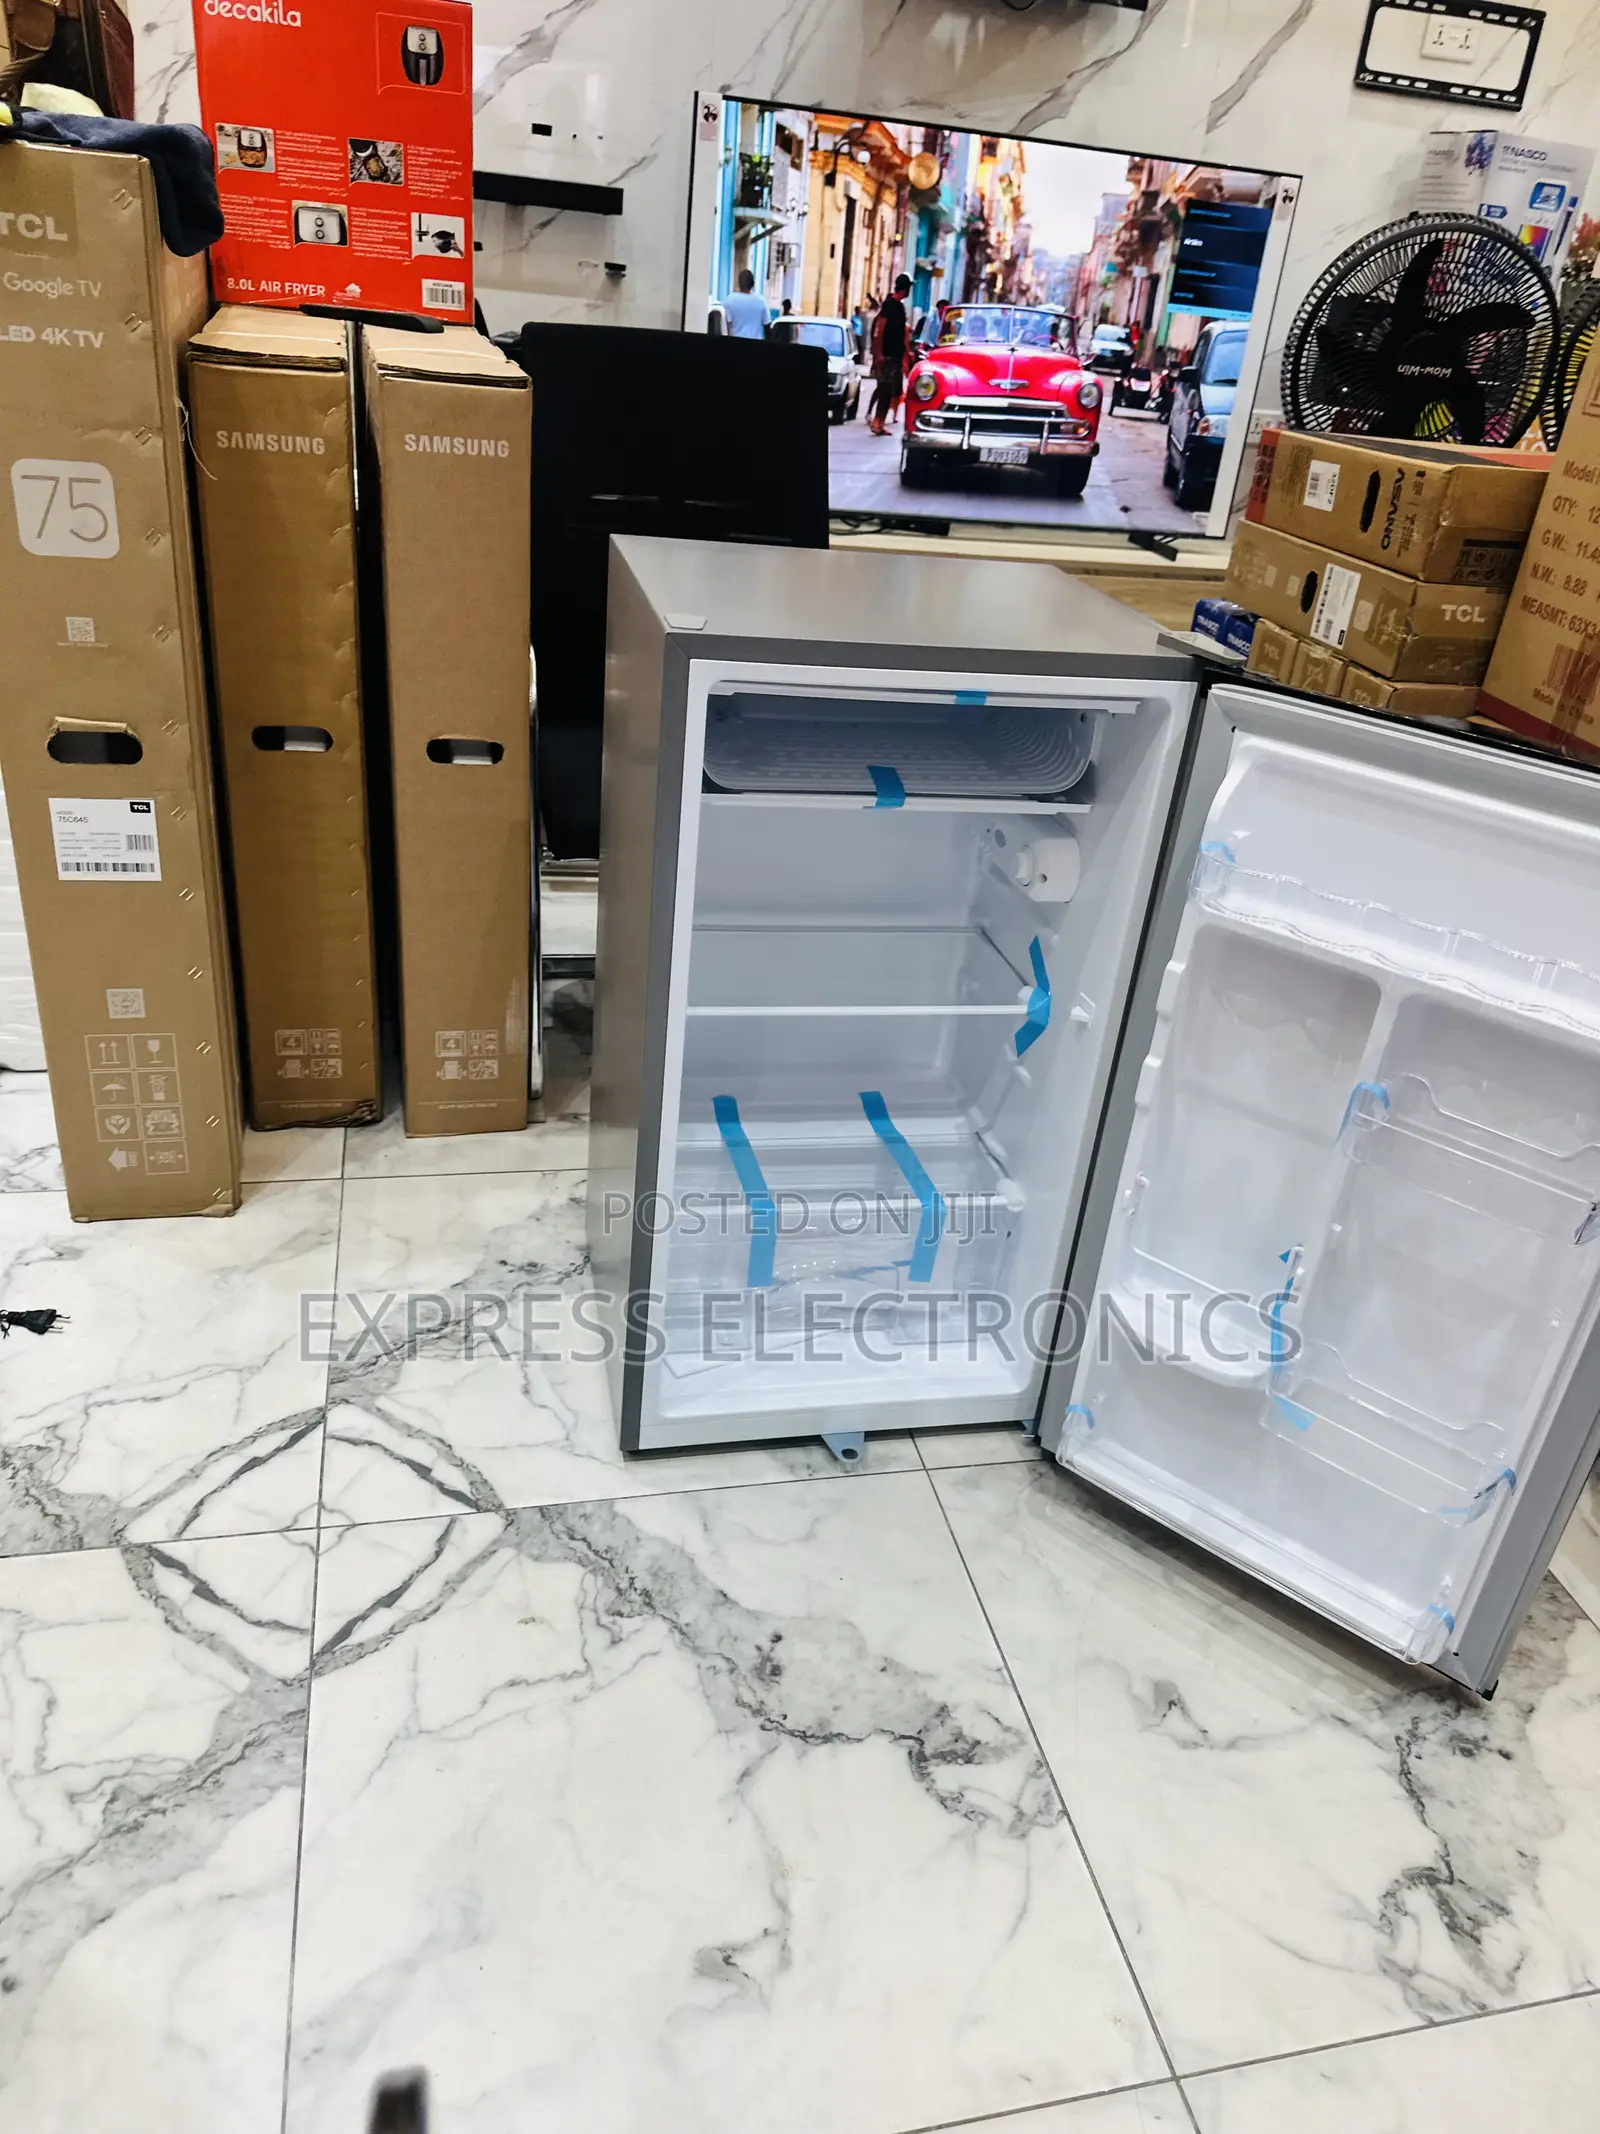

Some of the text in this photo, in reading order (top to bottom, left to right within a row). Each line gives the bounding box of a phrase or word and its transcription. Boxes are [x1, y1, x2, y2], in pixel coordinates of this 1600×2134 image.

[203, 0, 302, 27] decakila
[0, 211, 68, 241] TCL
[4, 271, 102, 299] Google TV
[227, 277, 255, 291] 8.0L
[259, 280, 281, 293] AIR
[284, 282, 326, 298] FRYER
[0, 325, 105, 349] ED 4K TV
[216, 430, 325, 455] SAMSUNG
[404, 433, 509, 458] SAMSUNG
[1562, 459, 1596, 484] Model
[20, 474, 108, 542] 75
[1381, 467, 1406, 551] ASANO
[1552, 495, 1578, 518] QTY:
[1440, 604, 1486, 623] TCL
[132, 804, 149, 812] TCL
